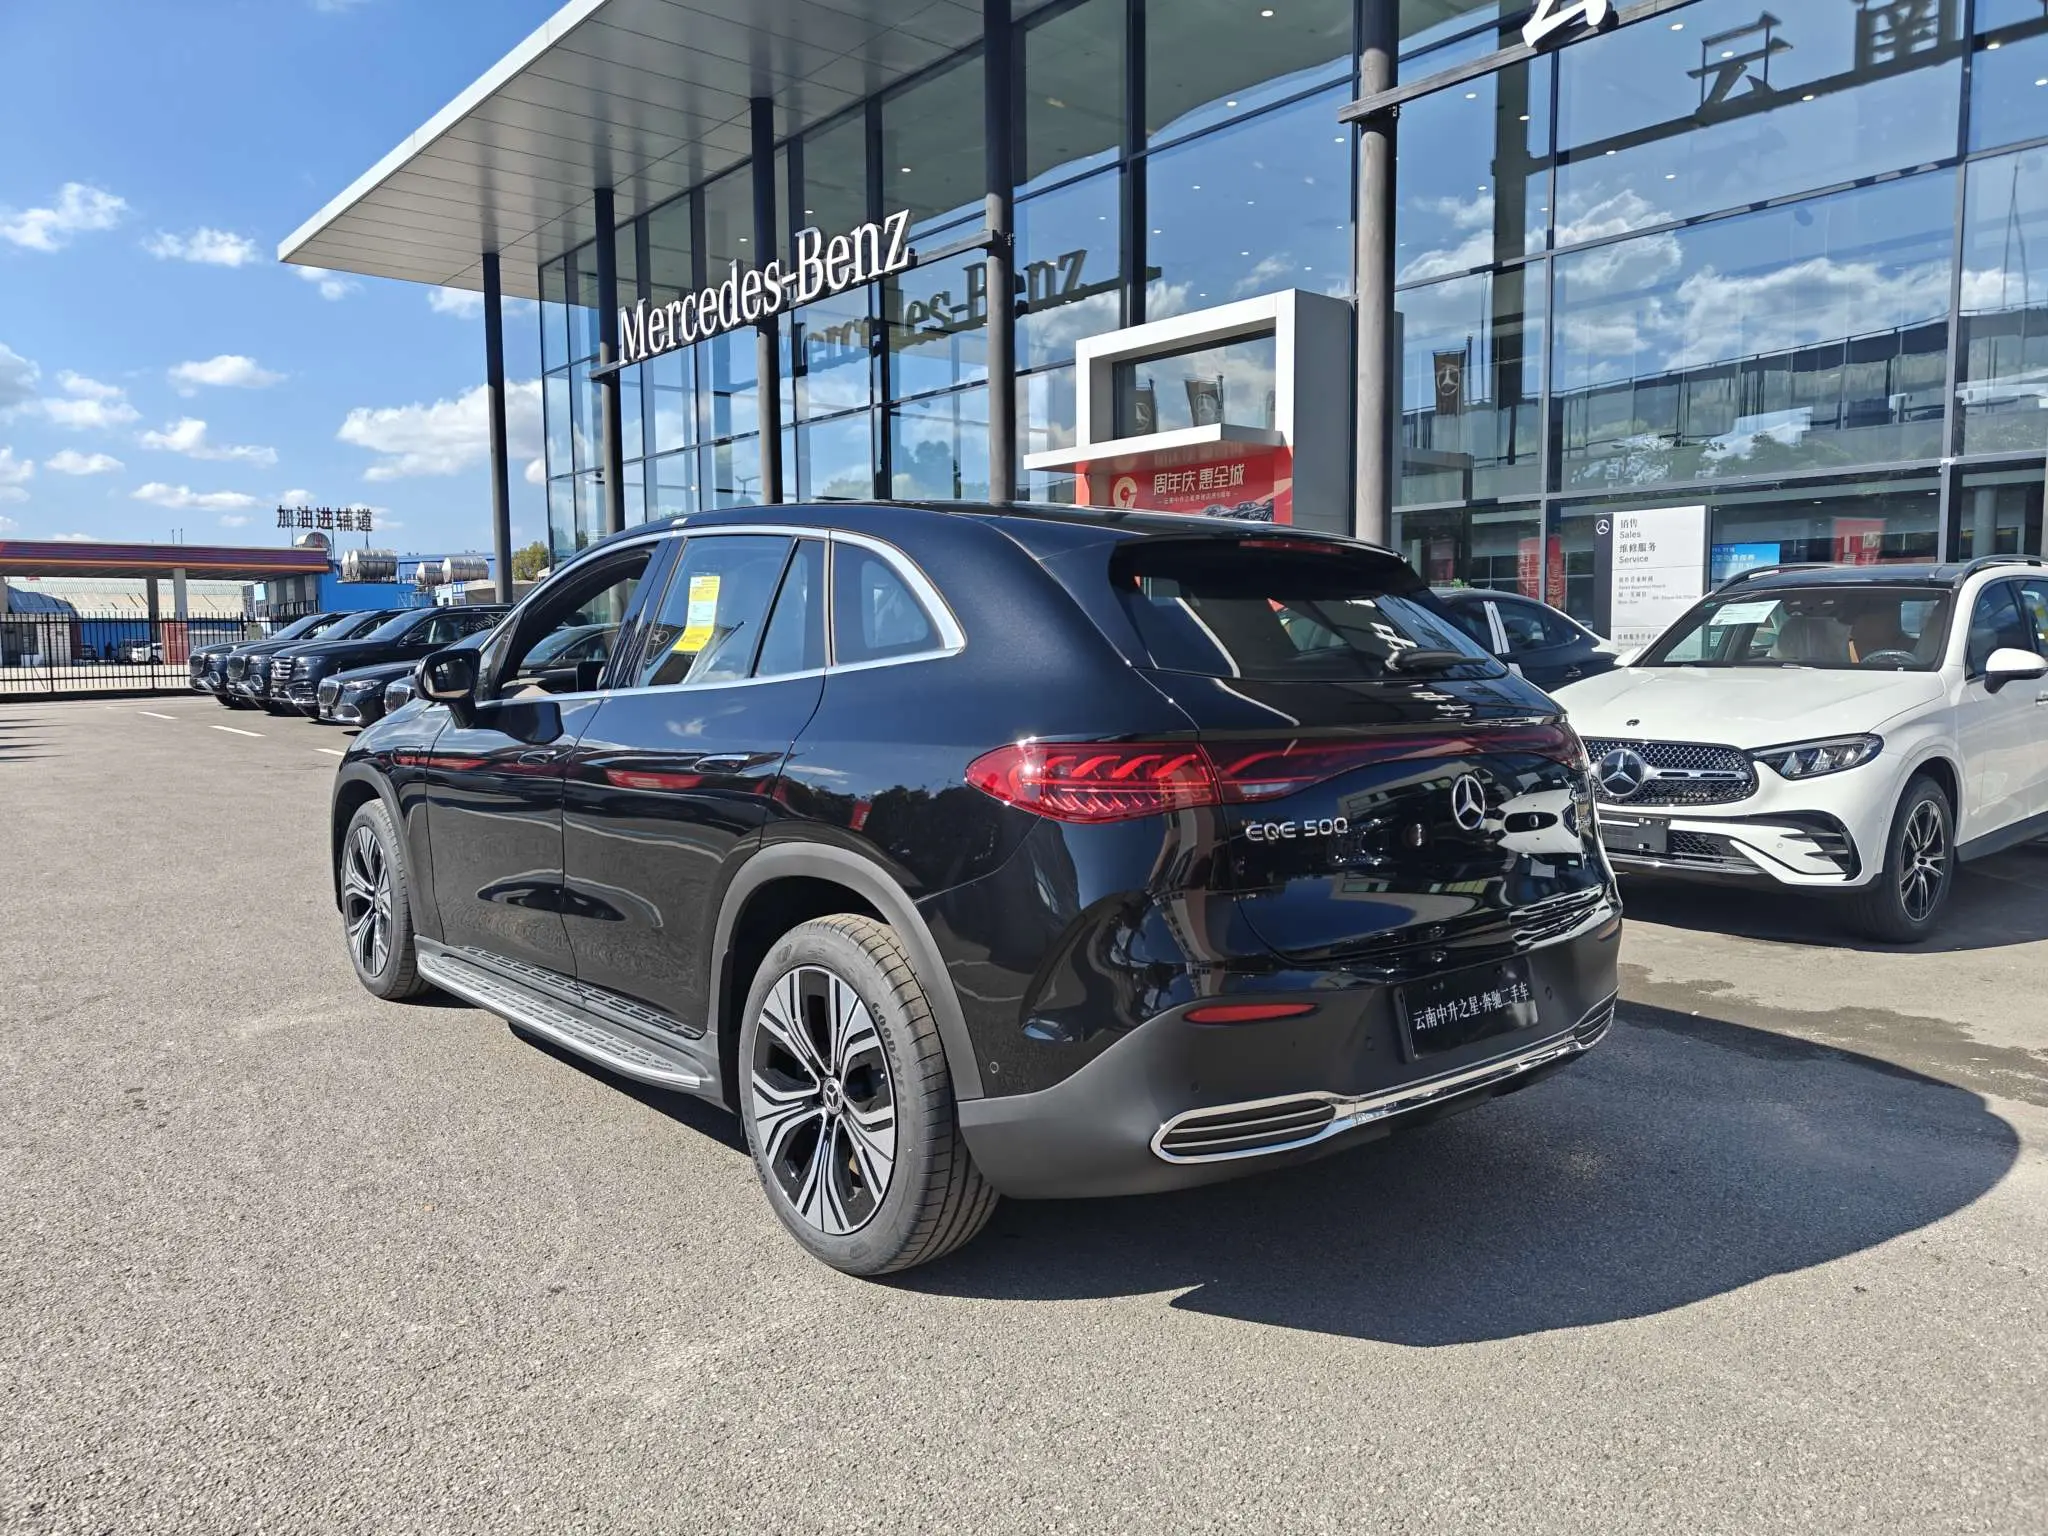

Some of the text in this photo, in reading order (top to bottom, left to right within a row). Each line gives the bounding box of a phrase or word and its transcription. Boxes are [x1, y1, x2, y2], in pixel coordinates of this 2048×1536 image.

[619, 208, 911, 365] Mercedes-Benz
[1153, 463, 1245, 496] 周年庆 惠全城
[277, 505, 373, 532] 加油进辅道
[1619, 530, 1641, 539] Sales
[1618, 555, 1649, 564] Service
[1619, 542, 1657, 554] 维修服务
[1245, 817, 1348, 842] EQE 500
